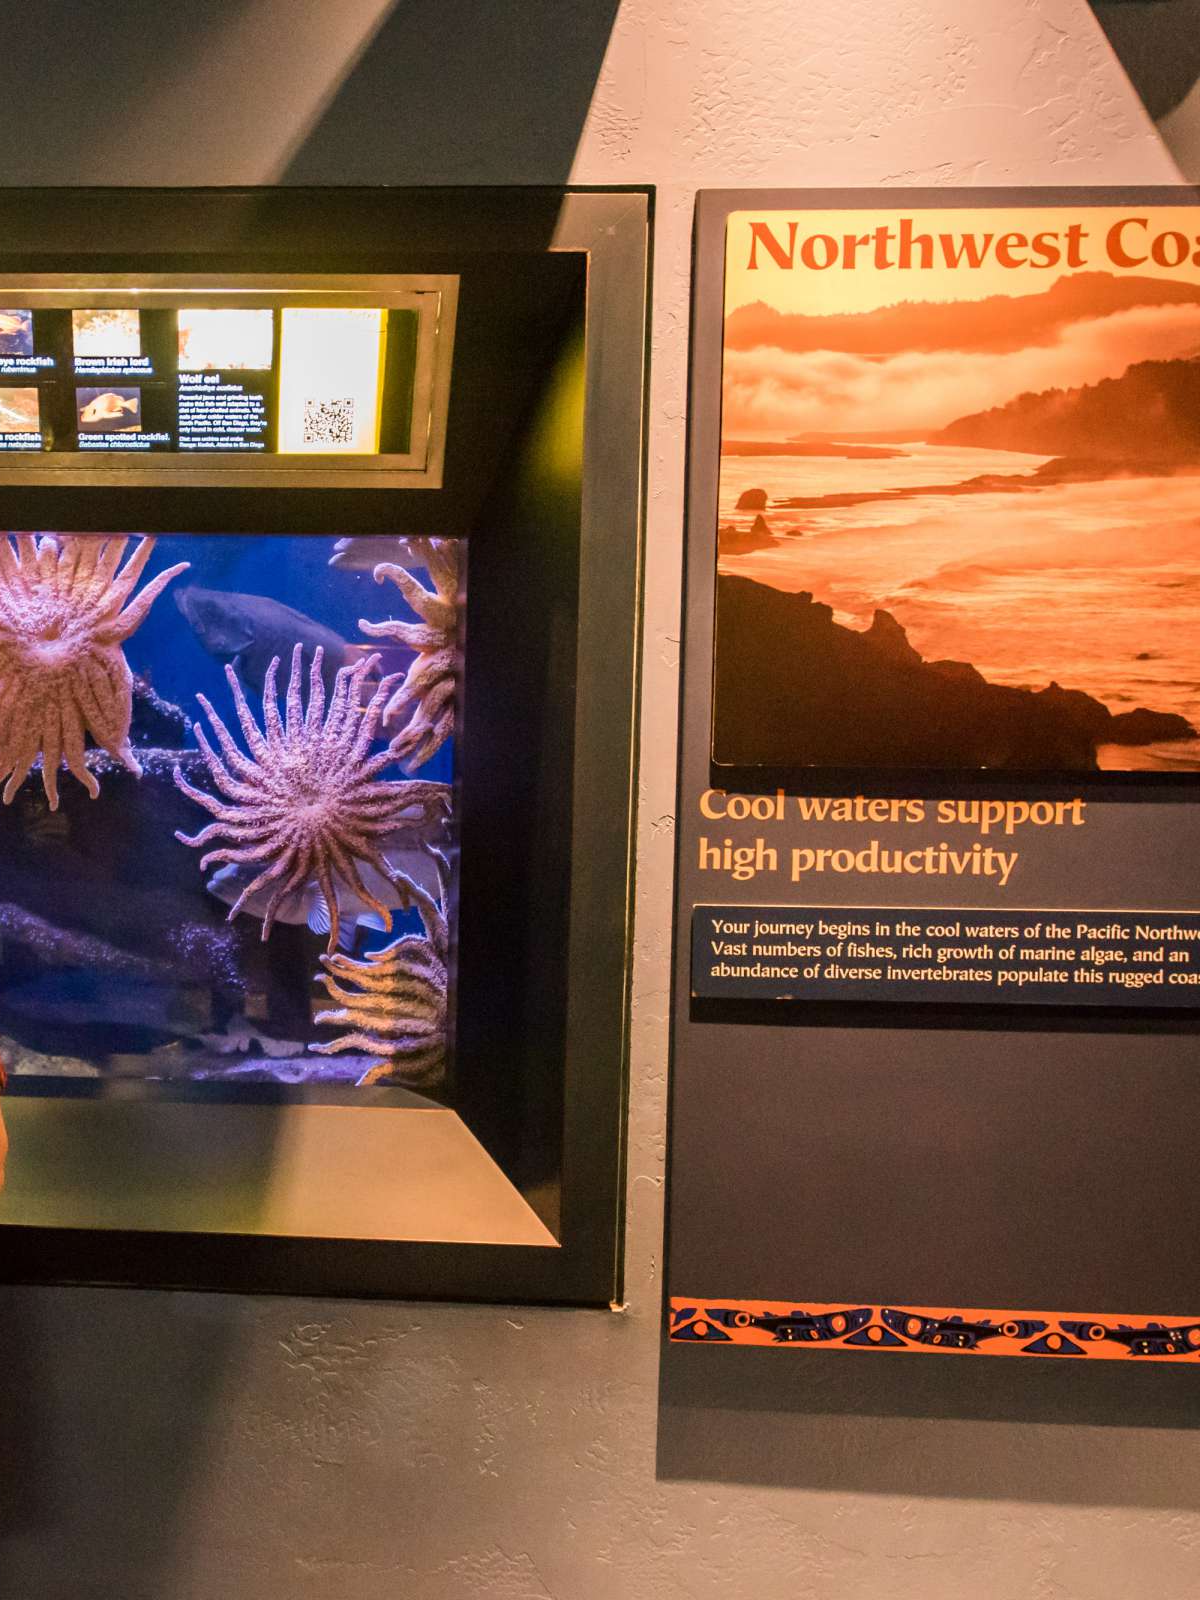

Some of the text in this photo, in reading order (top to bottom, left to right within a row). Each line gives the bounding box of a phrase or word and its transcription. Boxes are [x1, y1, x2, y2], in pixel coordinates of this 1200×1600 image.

[746, 217, 1200, 270] Northwest Co
[16, 357, 54, 366] rockfish
[75, 357, 149, 366] Brown Irish lord
[179, 374, 219, 384] Wolf eel
[4, 433, 41, 441] rockfish
[78, 433, 103, 441] Green
[105, 433, 136, 441] spotted
[700, 788, 1086, 835] Cool waters support
[699, 837, 1019, 886] high productivity
[711, 919, 1200, 940] Your journey begins in the cool waters of the Pacific Northw
[711, 941, 1190, 965] Vast numbers of fishes, rich growth of marine algae, and an
[711, 963, 1200, 988] abundance of diverse invertebrates populate this rugged coa
